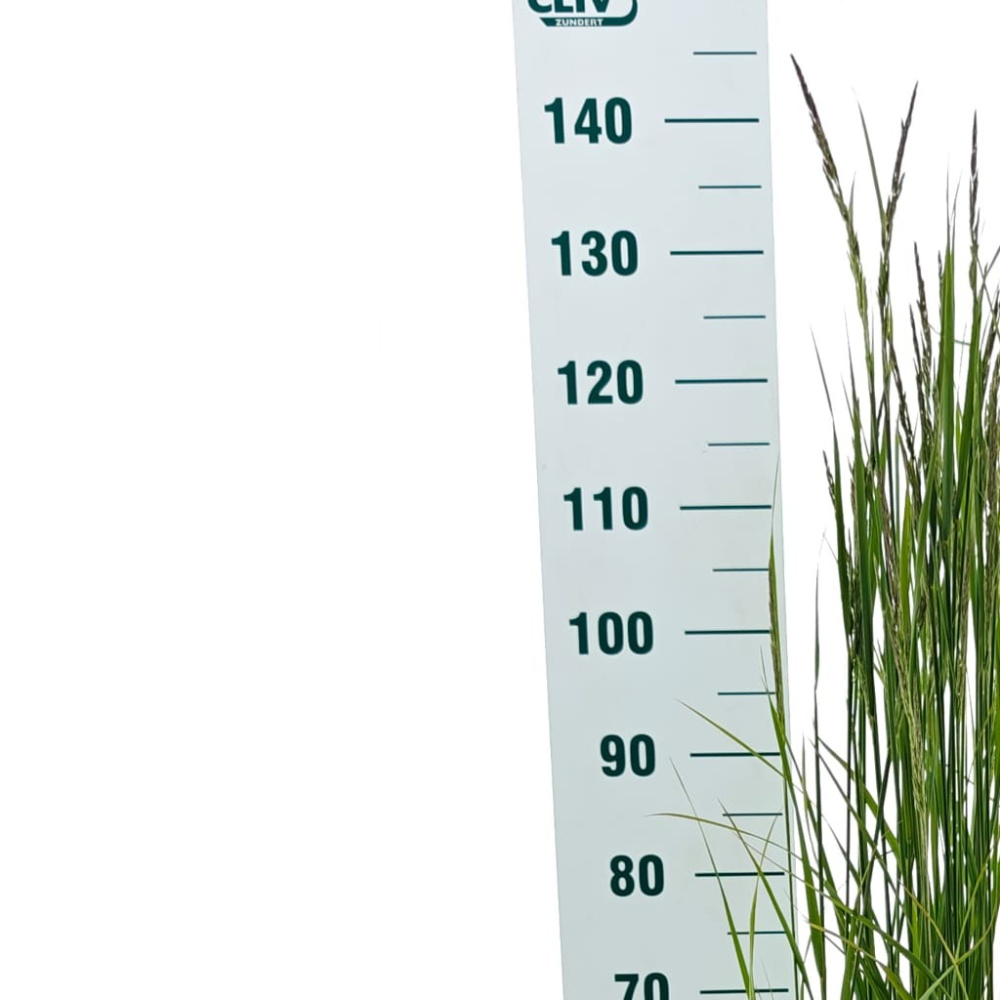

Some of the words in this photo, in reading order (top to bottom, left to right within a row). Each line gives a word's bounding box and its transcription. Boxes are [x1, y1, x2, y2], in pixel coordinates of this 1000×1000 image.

[555, 18, 604, 27] ZUNDERT
[544, 96, 632, 144] 140
[551, 230, 638, 277] 130
[557, 359, 644, 405] 120
[563, 486, 649, 531] 110
[568, 610, 654, 656] 100
[599, 733, 656, 778] 90
[609, 854, 664, 897] 80
